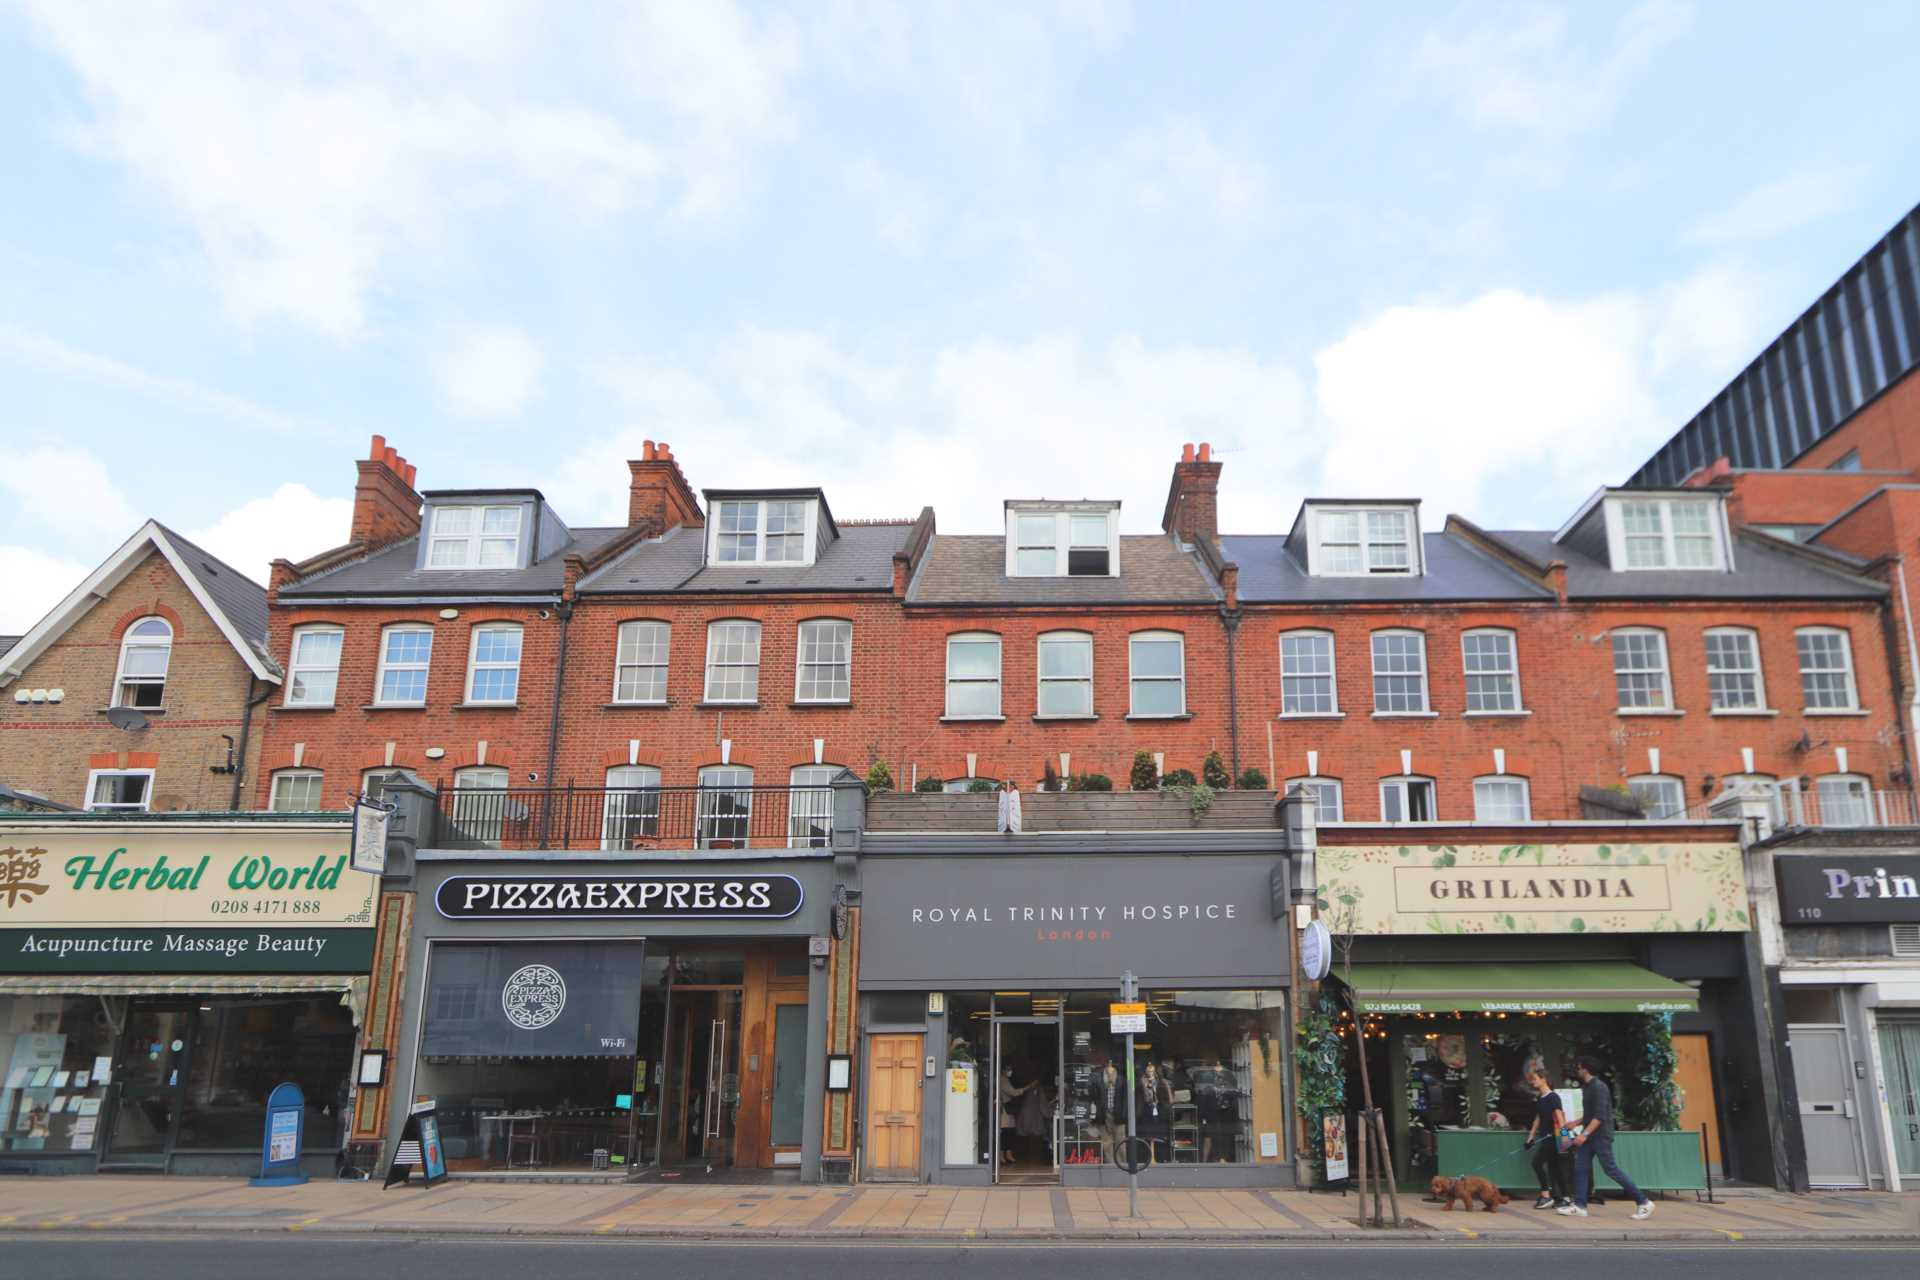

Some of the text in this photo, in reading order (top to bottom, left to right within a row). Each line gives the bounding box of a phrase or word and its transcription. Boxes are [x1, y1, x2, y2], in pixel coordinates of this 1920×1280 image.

[64, 847, 347, 890] Herbal World
[463, 882, 771, 909] PIZZAEXPRESS
[1430, 878, 1635, 899] GRILANDIA
[211, 900, 321, 914] 0208 4171 888
[912, 904, 1236, 922] ROYAL TRINITY HOSPICE
[1798, 908, 1822, 918] 110
[1036, 928, 1112, 941] London
[21, 934, 327, 957] Acupuncture Massage Beauty
[510, 994, 559, 1003] EXPRESS
[519, 986, 551, 995] PIZZA
